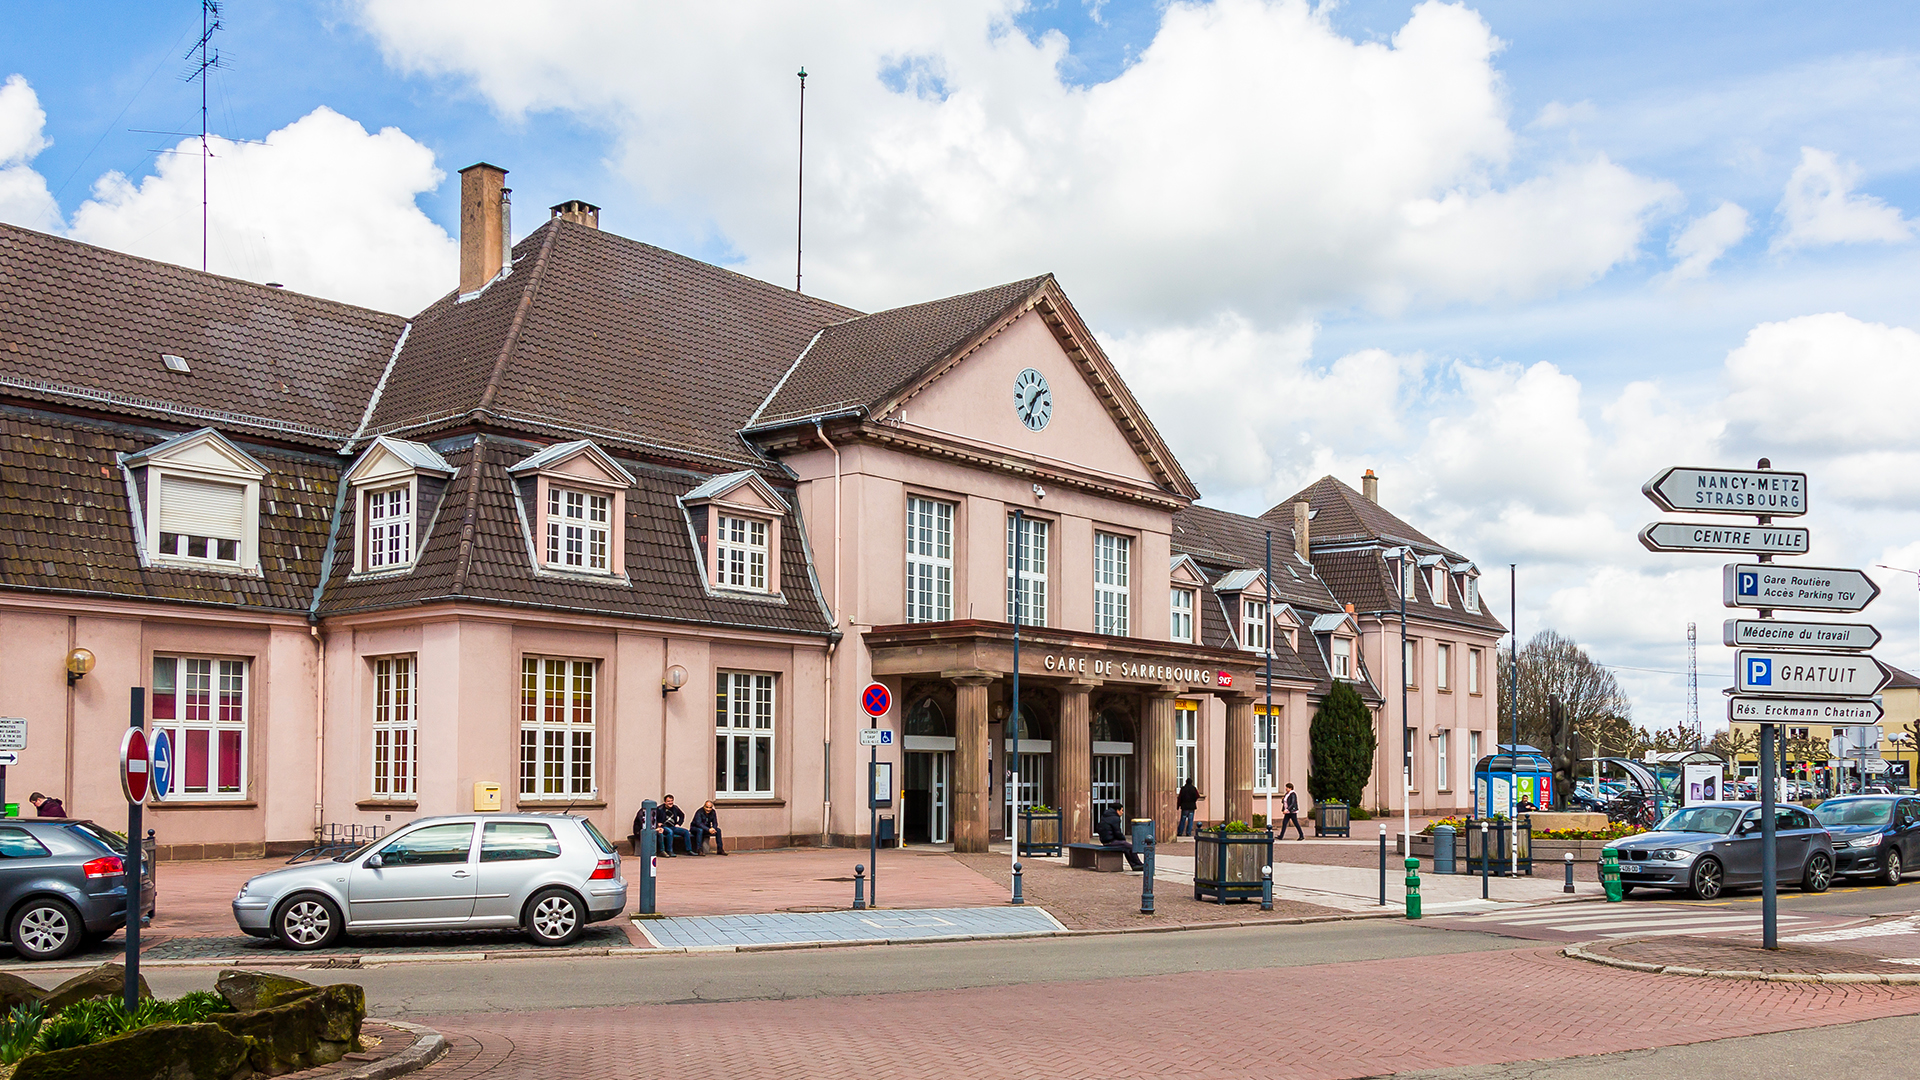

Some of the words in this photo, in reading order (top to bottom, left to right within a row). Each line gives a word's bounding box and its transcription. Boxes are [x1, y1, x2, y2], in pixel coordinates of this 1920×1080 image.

[1698, 475, 1799, 492] NANCY-METZ
[1695, 491, 1799, 508] STRASBOURG
[1693, 529, 1751, 545] CENTRE
[1763, 532, 1802, 547] VILLE
[1763, 574, 1786, 585] Gare
[1790, 576, 1831, 587] Routière
[1763, 587, 1794, 598] Accès
[1798, 589, 1834, 601] Parking
[1838, 591, 1856, 601] TGV
[1742, 626, 1794, 639] Médecine
[1799, 628, 1812, 639] du
[1817, 630, 1850, 641] travail
[1044, 654, 1086, 673] GARE
[1095, 659, 1112, 675] DE
[1121, 661, 1211, 684] SARREBOURG
[1781, 665, 1857, 683] GRATUIT
[1218, 675, 1232, 686] SNCF
[1736, 703, 1759, 715] Rés.
[1765, 704, 1819, 717] Erckmann
[1824, 706, 1872, 718] Chatrian
